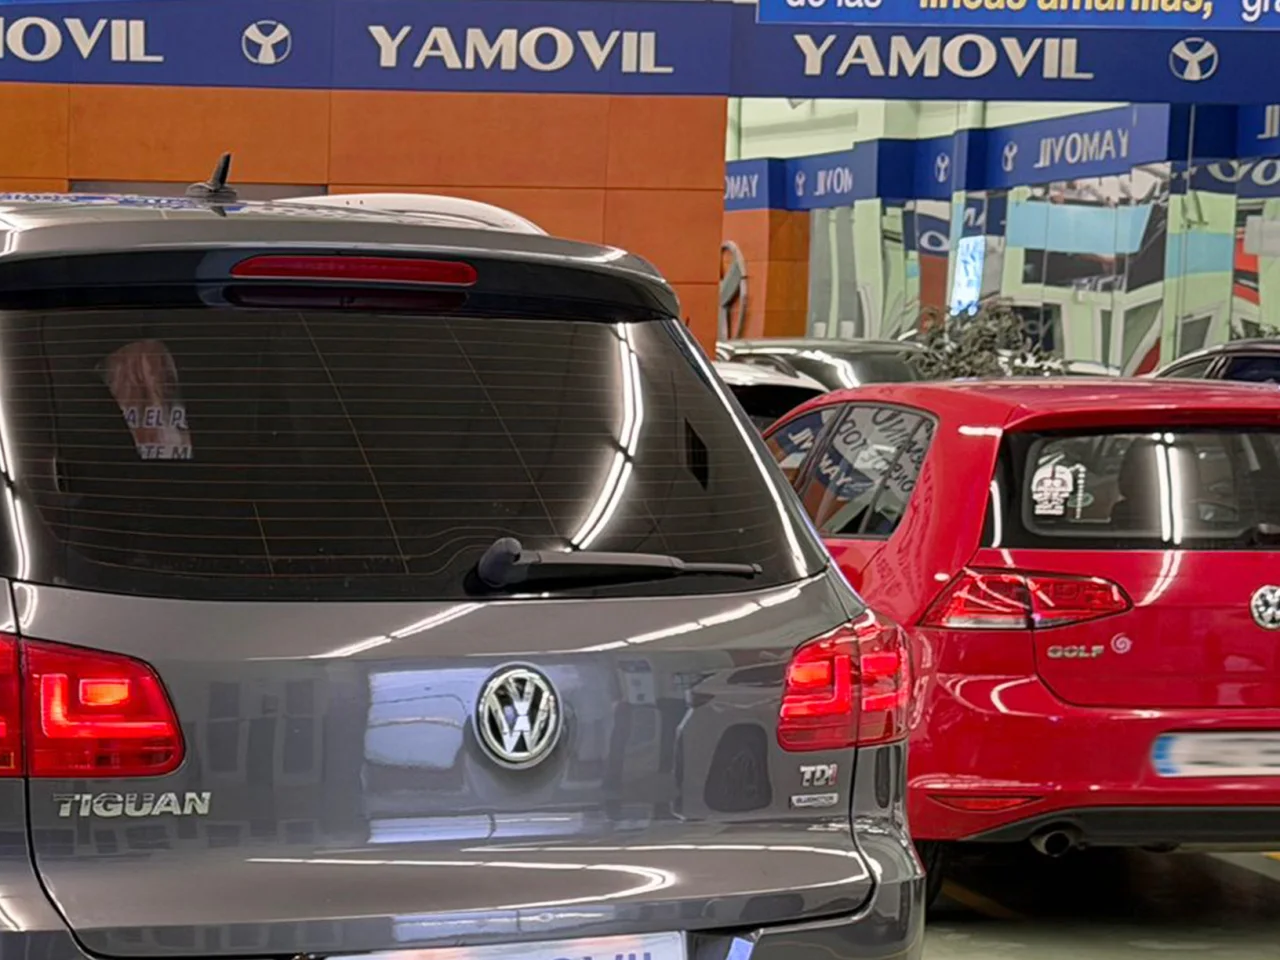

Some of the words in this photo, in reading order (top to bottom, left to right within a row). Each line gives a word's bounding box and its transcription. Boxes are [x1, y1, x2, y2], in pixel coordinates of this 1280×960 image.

[367, 25, 675, 74] YAMOVIL
[792, 33, 1095, 80] YAMOVIL
[799, 763, 838, 787] TDI
[52, 791, 212, 818] TIGUAN
